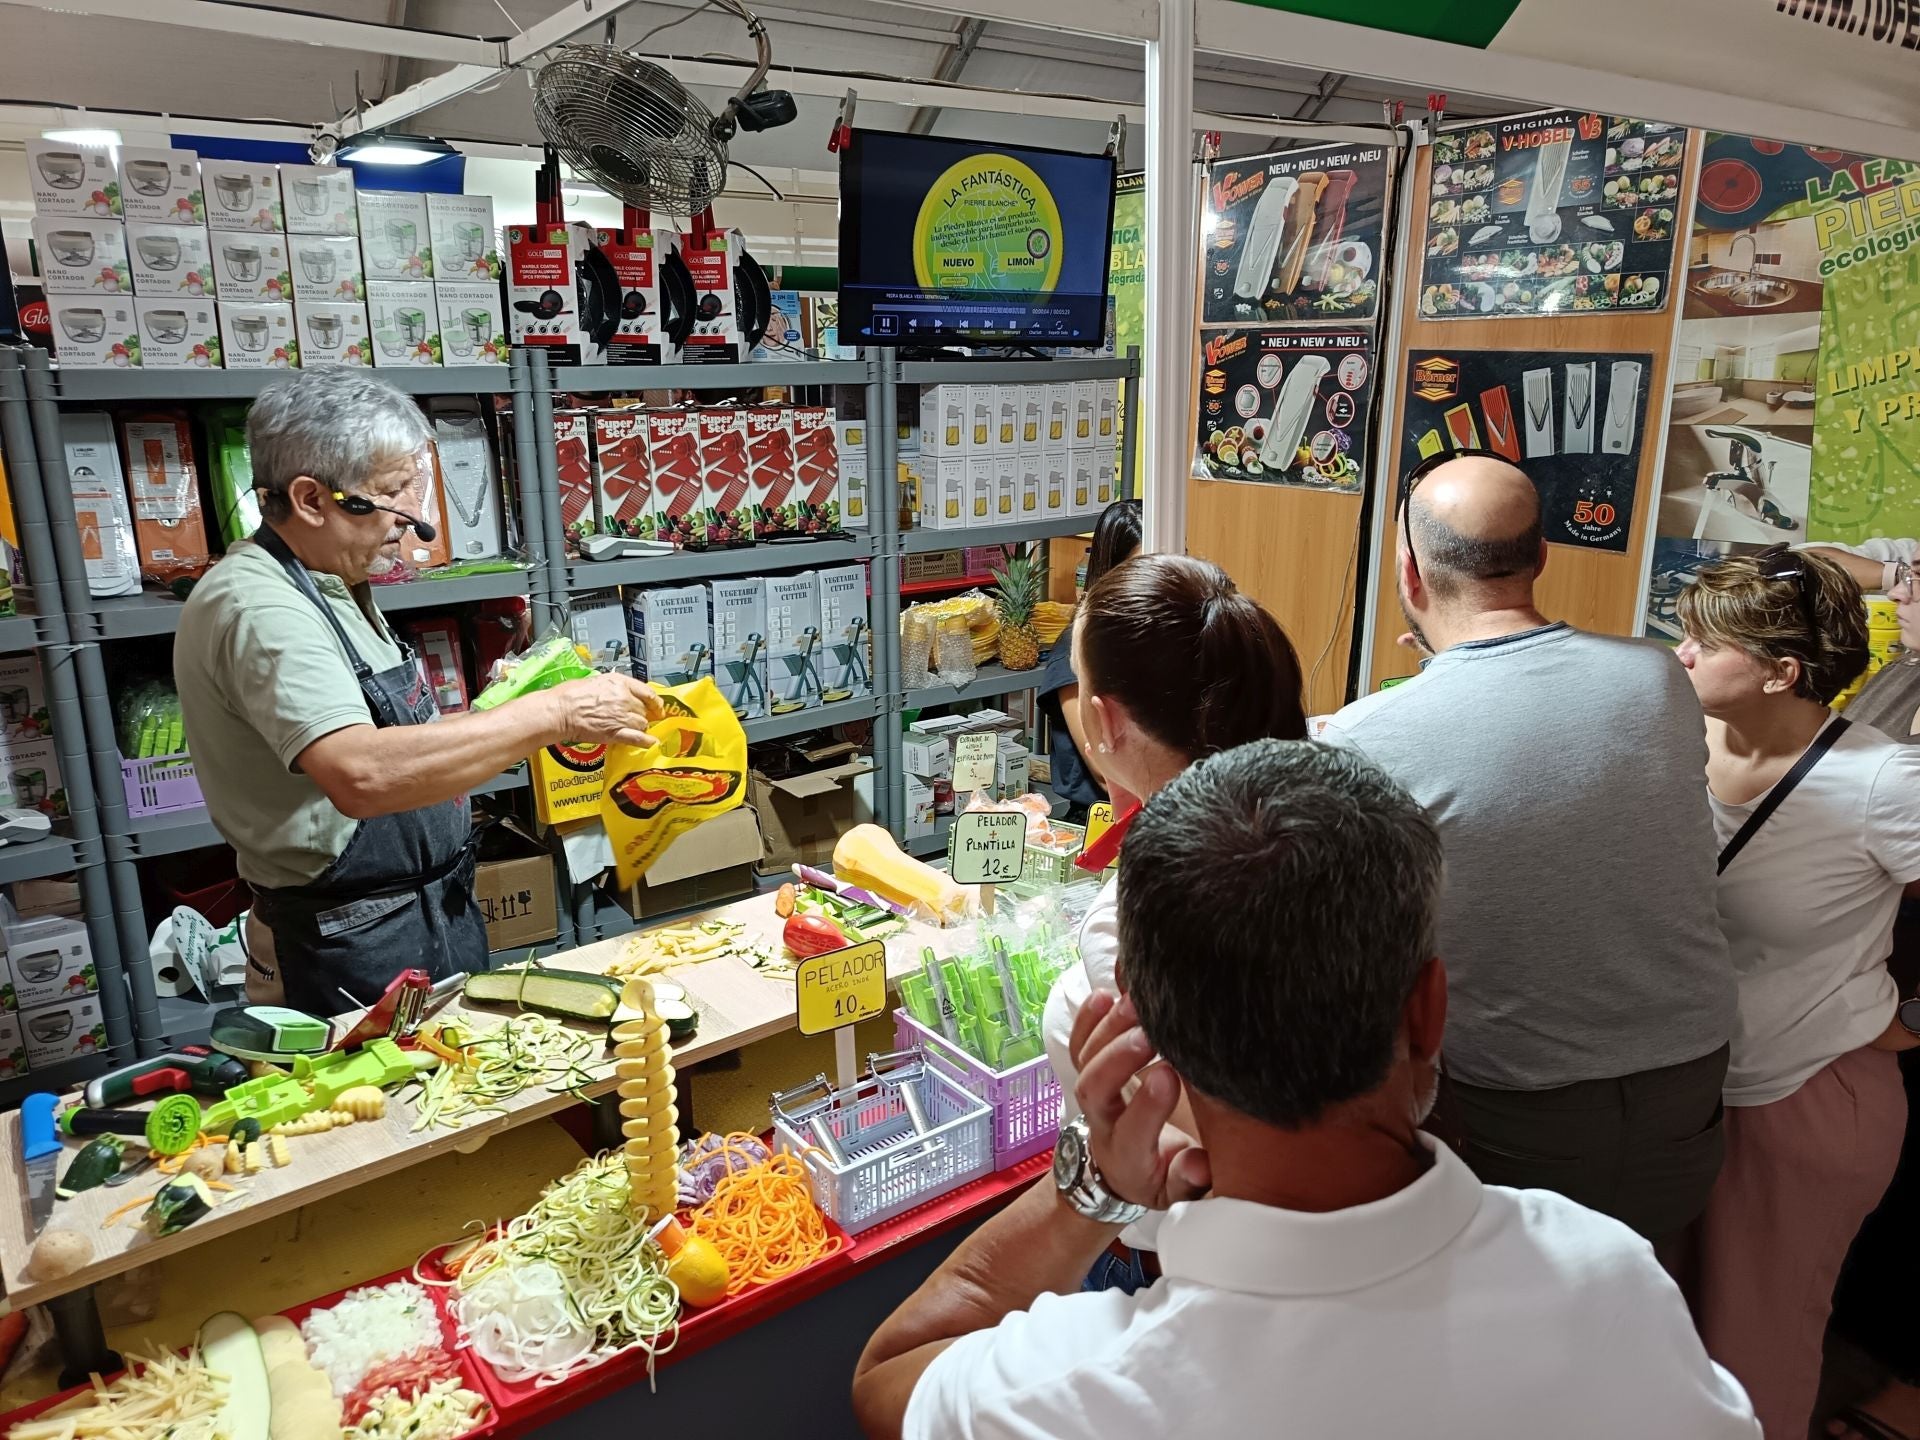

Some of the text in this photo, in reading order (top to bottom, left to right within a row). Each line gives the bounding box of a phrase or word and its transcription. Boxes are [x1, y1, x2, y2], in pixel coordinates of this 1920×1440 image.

[1503, 116, 1572, 132] ORIGINAL
[1502, 128, 1573, 151] V-HOBEL
[1269, 150, 1381, 175] NEW NEU NEW NEU
[944, 169, 1036, 210] LA FANTÁSTICA
[1807, 170, 1857, 203] LA
[944, 223, 965, 231] Piedra
[1008, 210, 1036, 221] producto
[1815, 181, 1920, 251] PIED
[931, 229, 977, 242] indispensable
[979, 226, 993, 236] para
[995, 220, 1023, 230] limpiarlo
[1113, 228, 1140, 244] TICA
[941, 239, 960, 247] desde
[970, 232, 988, 243] techo
[943, 258, 974, 267] NUEVO
[1111, 248, 1145, 271] BLA
[1109, 272, 1145, 285] degrada
[24, 308, 51, 326] Glo
[1268, 337, 1360, 347] NEU NEW NEU
[1415, 369, 1456, 383] Börner
[1827, 346, 1920, 396] LIMPI
[748, 413, 778, 423] Super
[794, 411, 824, 421] Super
[1843, 392, 1920, 434] Y PR
[598, 419, 633, 429] Super
[650, 416, 684, 427] Super
[700, 415, 733, 425] Super
[755, 422, 773, 431] Set
[801, 420, 818, 429] Set
[606, 429, 628, 438] Set
[658, 426, 678, 436] Set
[707, 424, 726, 433] Set
[1573, 501, 1615, 526] 50
[1564, 520, 1580, 538] Made
[1589, 526, 1622, 542] Germany
[824, 573, 859, 584] VEGETABLE
[719, 587, 758, 598] VEGETABLE
[774, 582, 812, 593] VEGETABLE
[830, 582, 855, 592] CUTTER
[654, 596, 699, 606] VEGETABLE
[726, 596, 753, 606] CUTTER
[780, 590, 808, 601] CUTTER
[663, 606, 694, 616] CUTTER
[4, 751, 47, 762] CORTADOR
[562, 751, 578, 765] Made
[550, 771, 604, 792] piedrabl
[553, 792, 602, 808] WWW.TUFE
[977, 815, 1018, 827] PELADOR
[1094, 807, 1114, 822] PEL
[966, 838, 1015, 852] PLANTILLA
[805, 951, 884, 988] PELADOR
